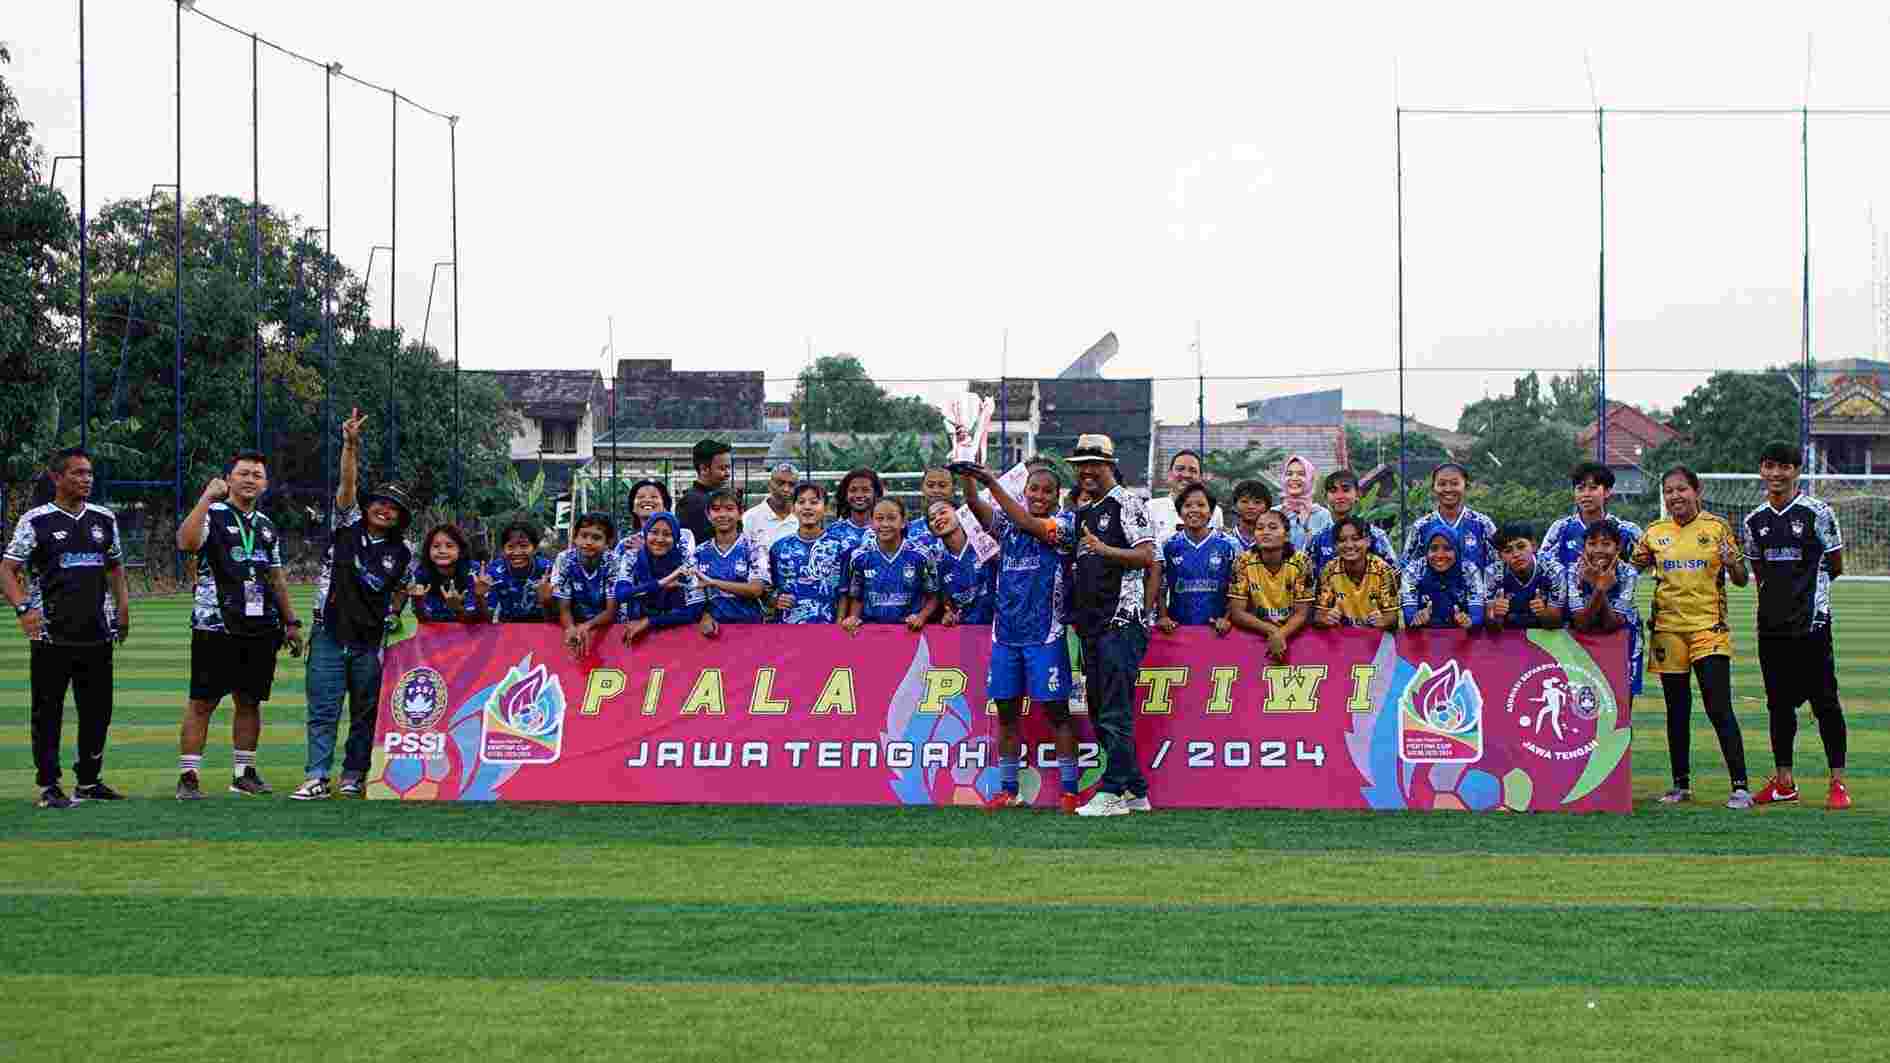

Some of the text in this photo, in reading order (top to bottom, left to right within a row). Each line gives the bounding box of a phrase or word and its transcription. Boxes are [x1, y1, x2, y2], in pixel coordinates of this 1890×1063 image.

[580, 664, 1378, 715] PIALA PTIWI
[384, 732, 446, 753] PSSI
[627, 741, 769, 768] JAWA
[784, 741, 986, 768] TENGAH
